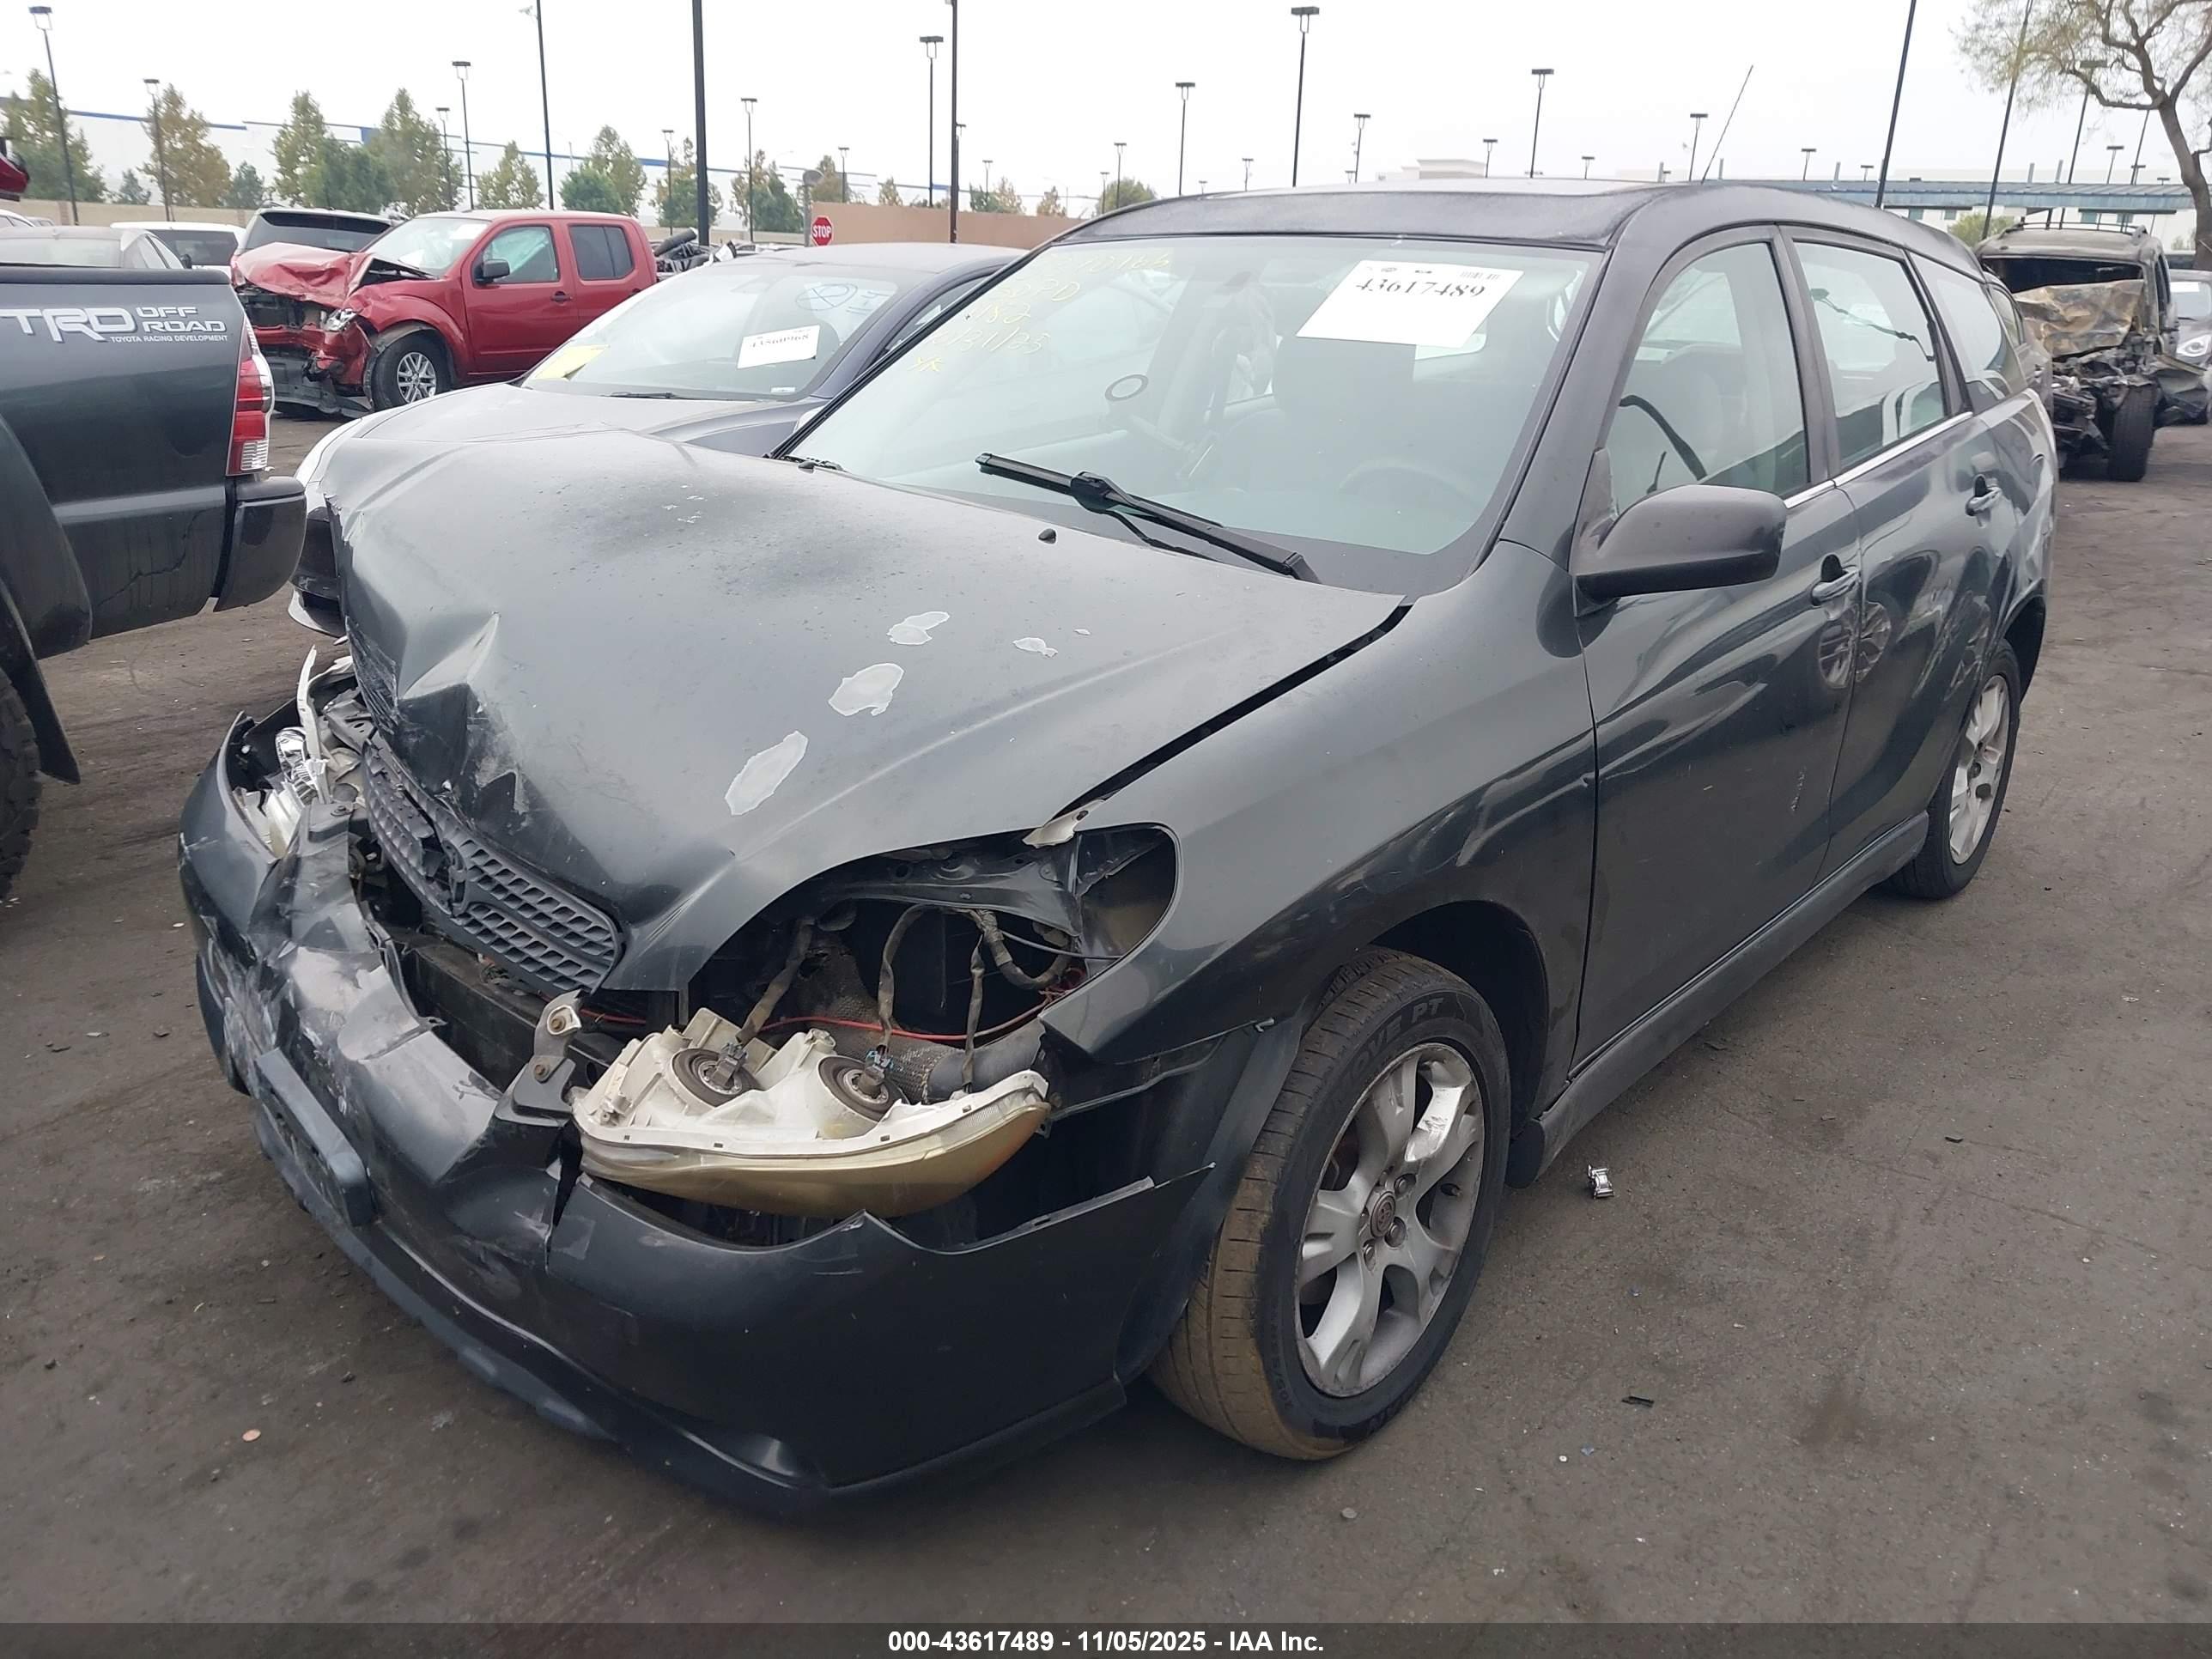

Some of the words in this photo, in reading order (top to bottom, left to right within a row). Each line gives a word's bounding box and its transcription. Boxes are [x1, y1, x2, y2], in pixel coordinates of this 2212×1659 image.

[812, 225, 831, 238] STOP
[1355, 278, 1486, 297] 43617489
[136, 307, 198, 318] OFF
[0, 307, 135, 343] TRD
[142, 320, 227, 332] ROAD
